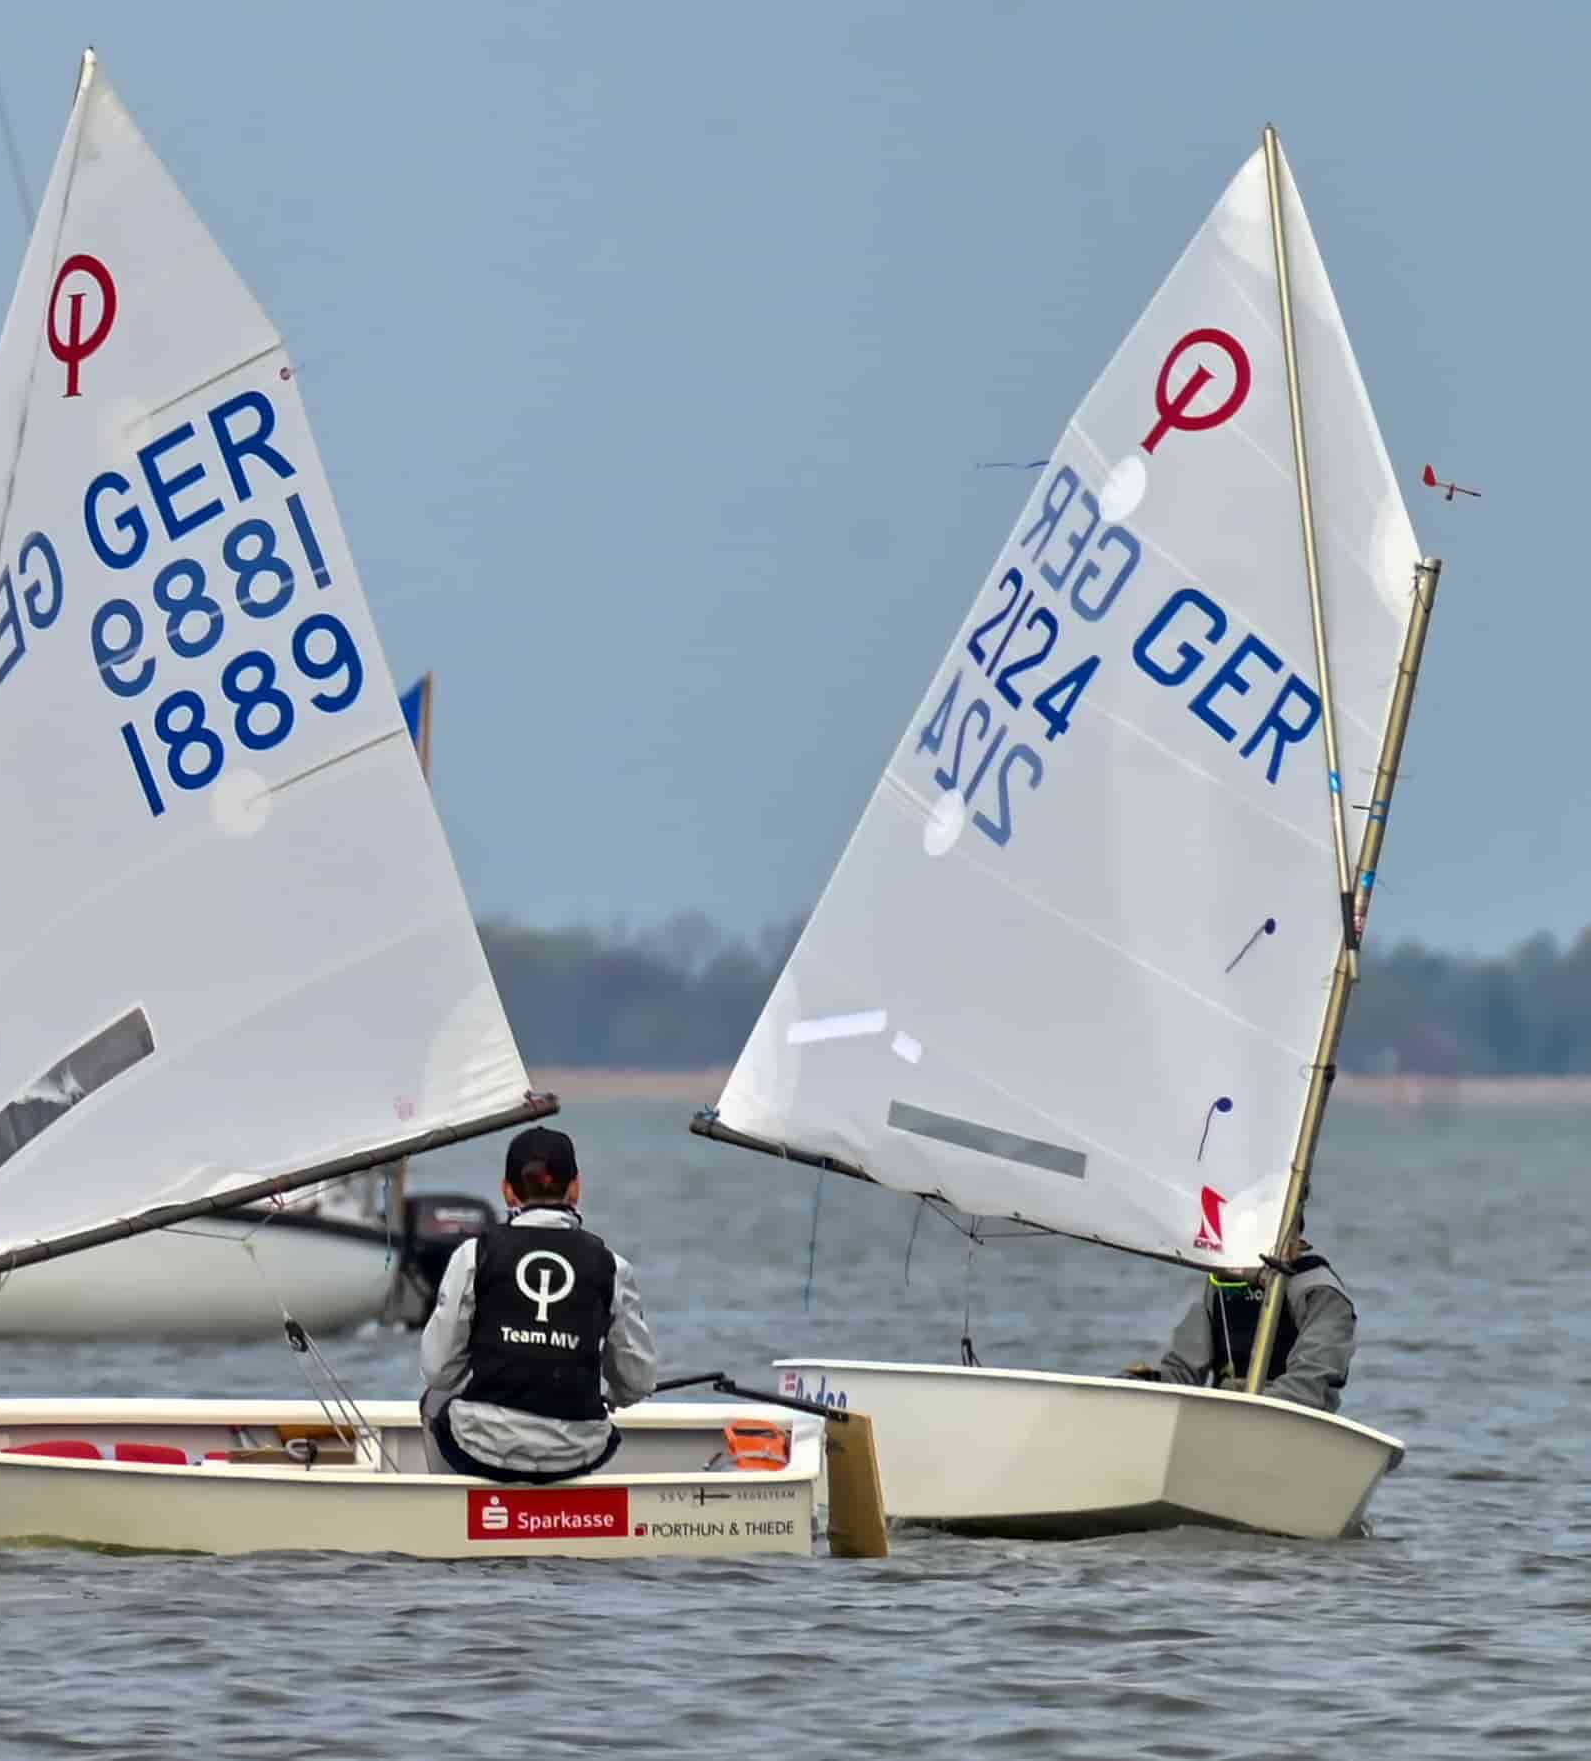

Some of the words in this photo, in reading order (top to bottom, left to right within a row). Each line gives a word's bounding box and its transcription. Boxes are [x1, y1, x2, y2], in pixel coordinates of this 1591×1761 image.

[85, 391, 296, 569] GER
[121, 614, 364, 817] 1889
[967, 569, 1101, 742] 2124
[1132, 588, 1321, 784] GER
[501, 1327, 547, 1343] Team
[550, 1331, 580, 1349] MV
[517, 1510, 614, 1532] Sparkasse
[652, 1522, 724, 1536] PORTHUN
[729, 1522, 739, 1536] &
[744, 1520, 794, 1535] THIEDE
